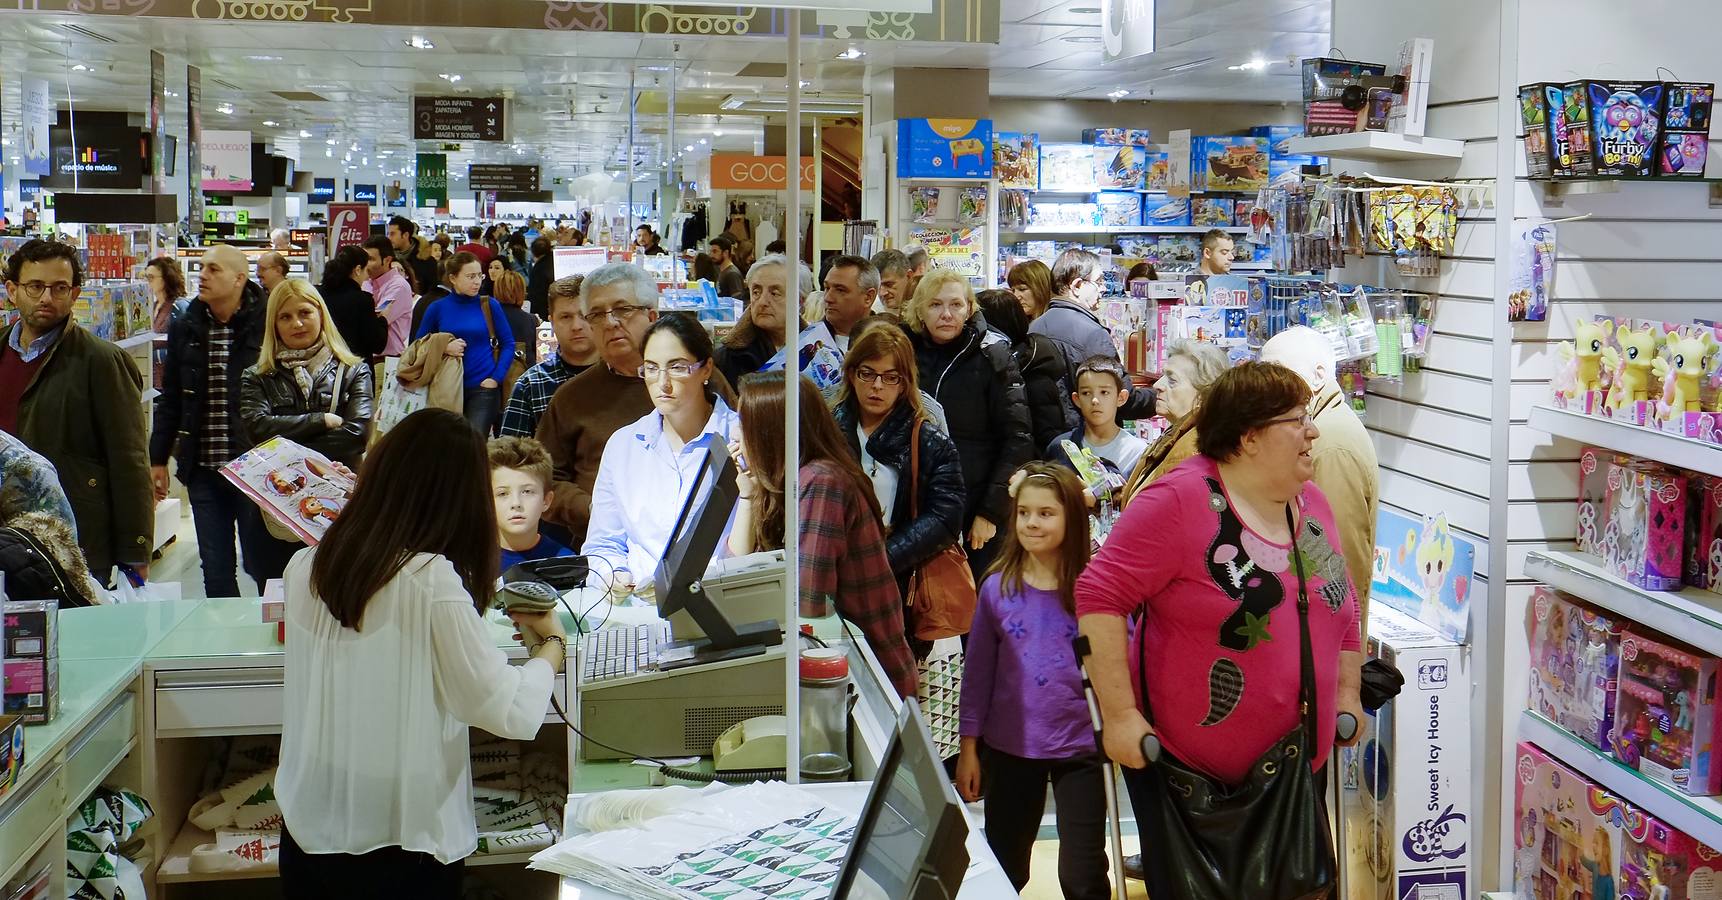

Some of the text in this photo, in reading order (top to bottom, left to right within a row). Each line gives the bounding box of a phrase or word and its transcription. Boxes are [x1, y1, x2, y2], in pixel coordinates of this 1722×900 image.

[452, 100, 474, 108] INFANTIL
[420, 111, 431, 132] 3
[1604, 142, 1644, 156] Furby
[61, 164, 84, 173] espacio
[94, 164, 118, 172] música
[238, 213, 245, 221] 2
[330, 209, 363, 260] feliz
[1428, 694, 1442, 811] Sweet Icy House
